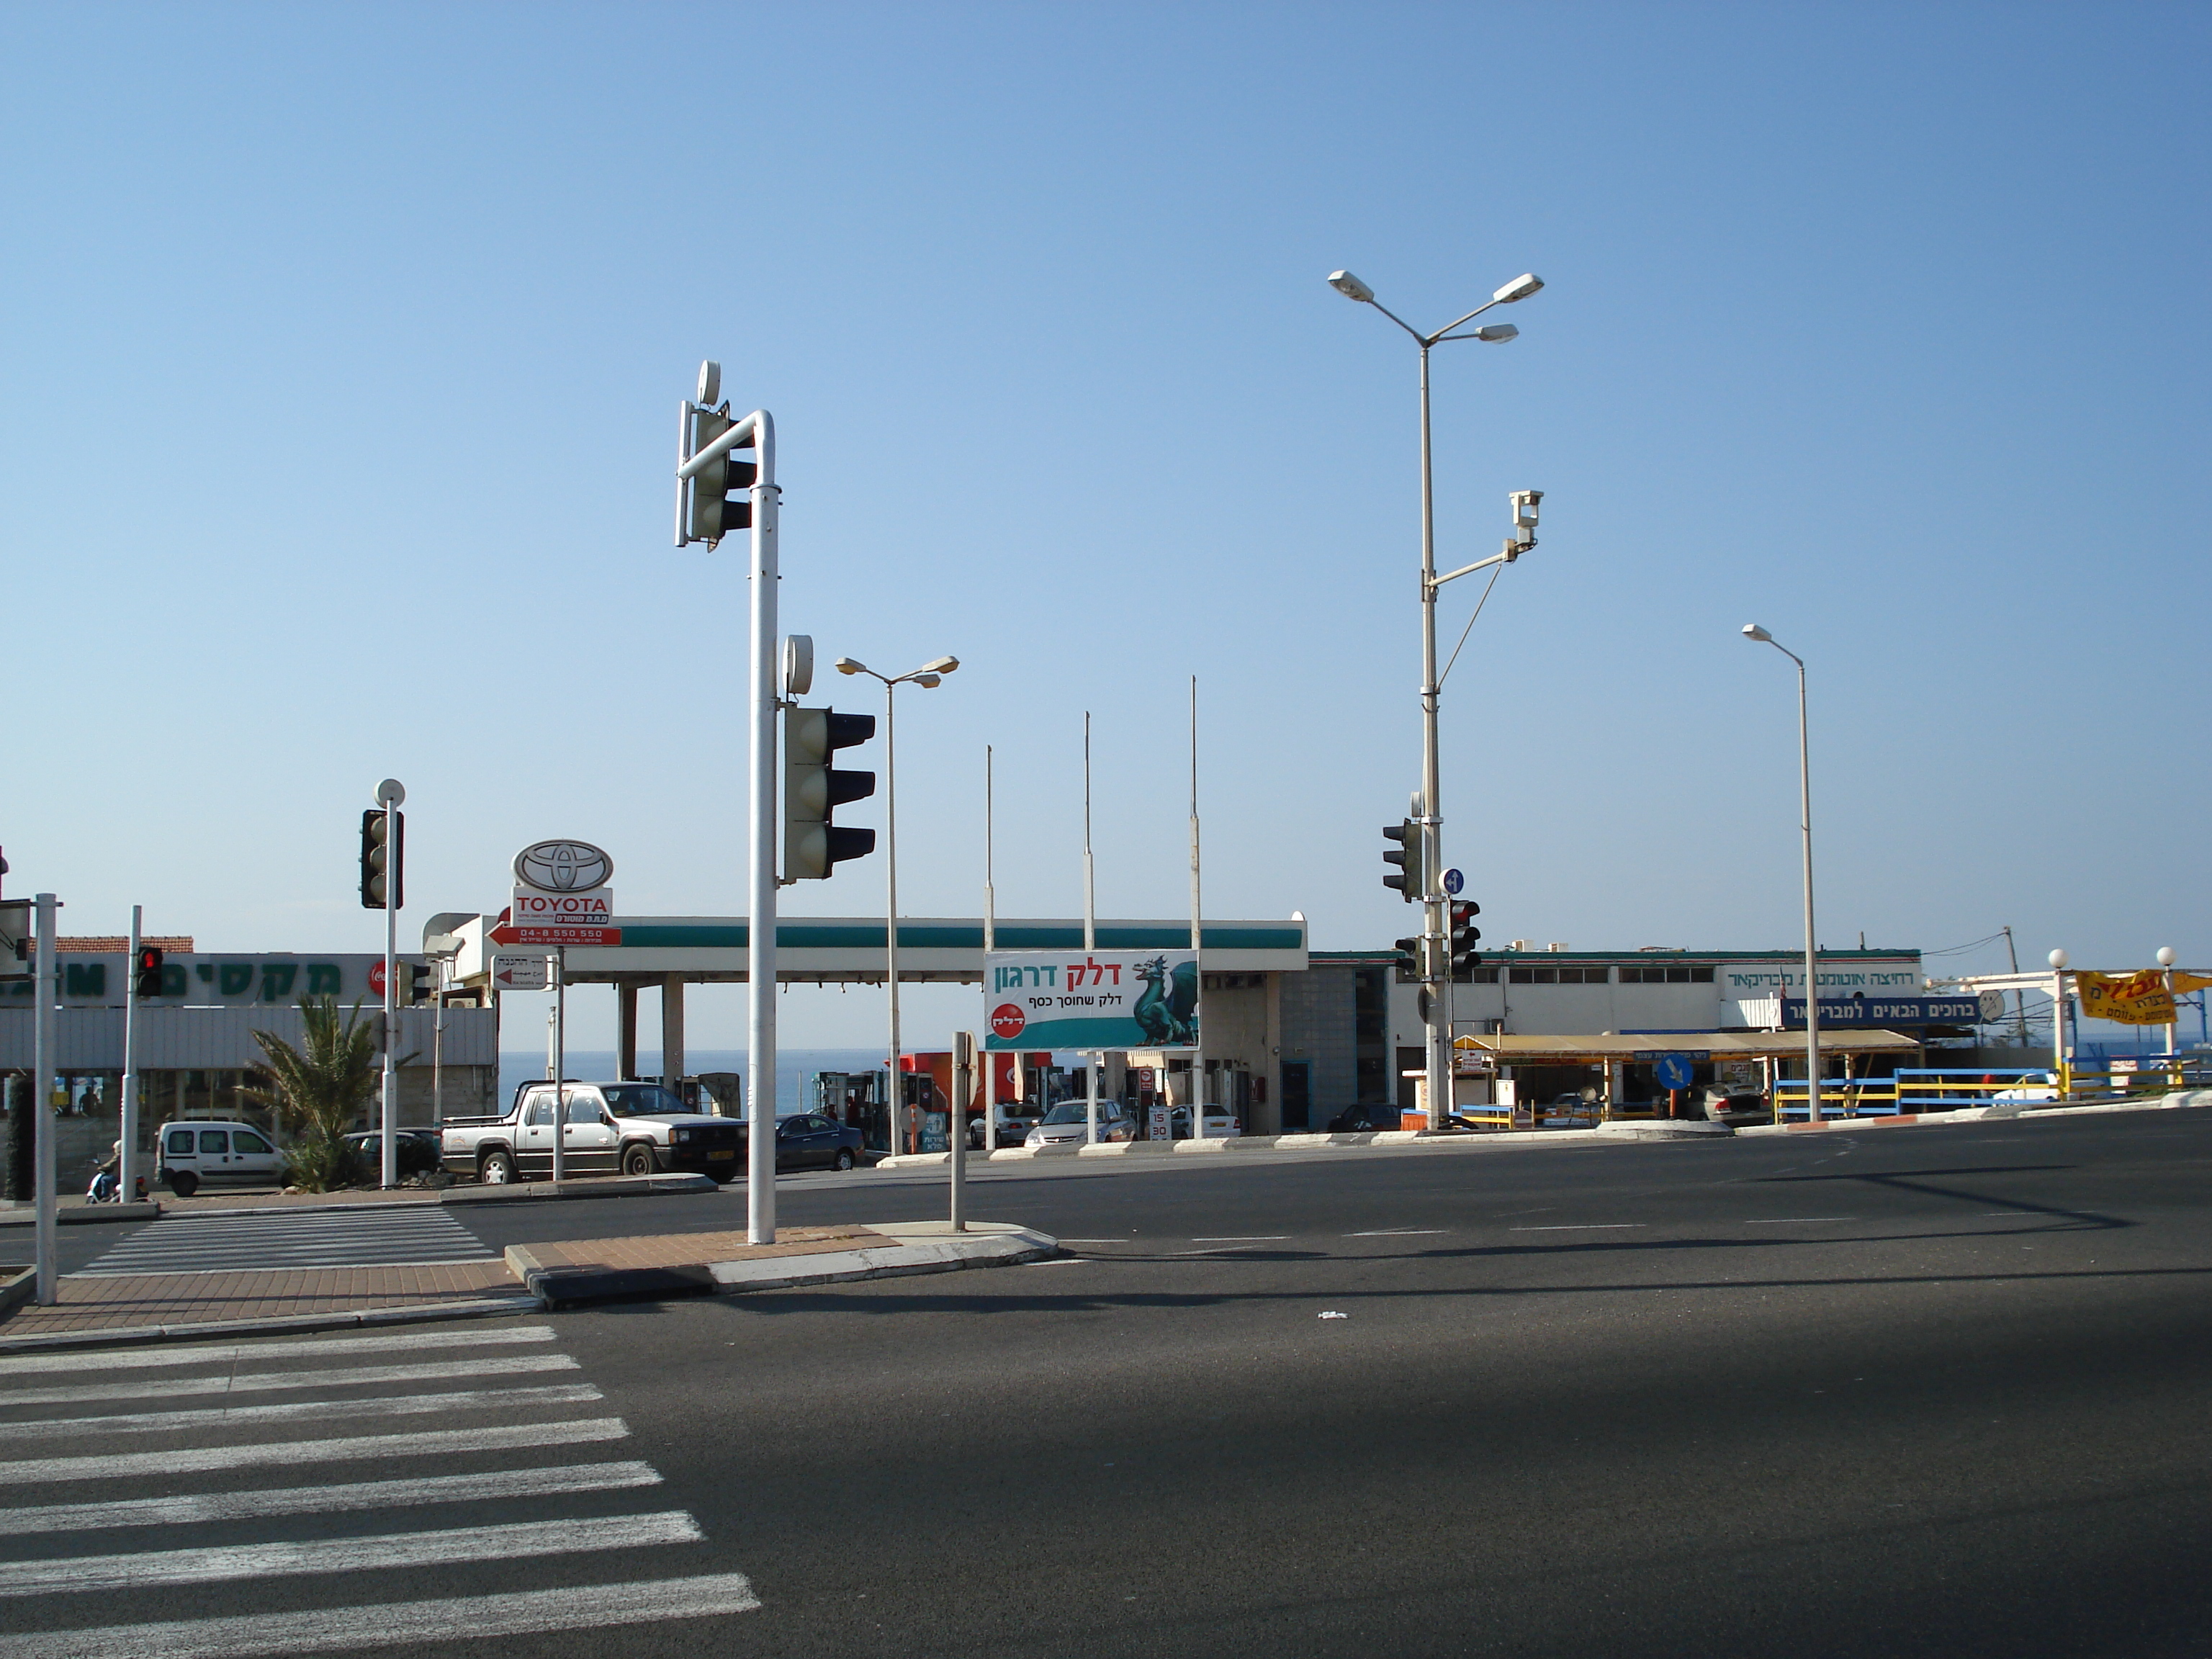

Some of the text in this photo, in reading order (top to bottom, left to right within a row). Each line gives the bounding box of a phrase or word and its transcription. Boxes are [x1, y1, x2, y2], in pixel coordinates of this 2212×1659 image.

[516, 897, 607, 912] TOYOTA
[994, 956, 1122, 994] דלק דרגון
[1798, 973, 1866, 986] אוטומטת
[1870, 972, 1915, 986] רחיצה
[160, 963, 341, 1002] מקסים
[1028, 992, 1122, 1009] דלק שחוסך כסף
[1789, 1000, 1975, 1019] ברוכים הבאים למבריאר
[992, 1015, 1025, 1028] דלק
[1154, 1113, 1164, 1123] 15
[1153, 1127, 1166, 1136] 30
